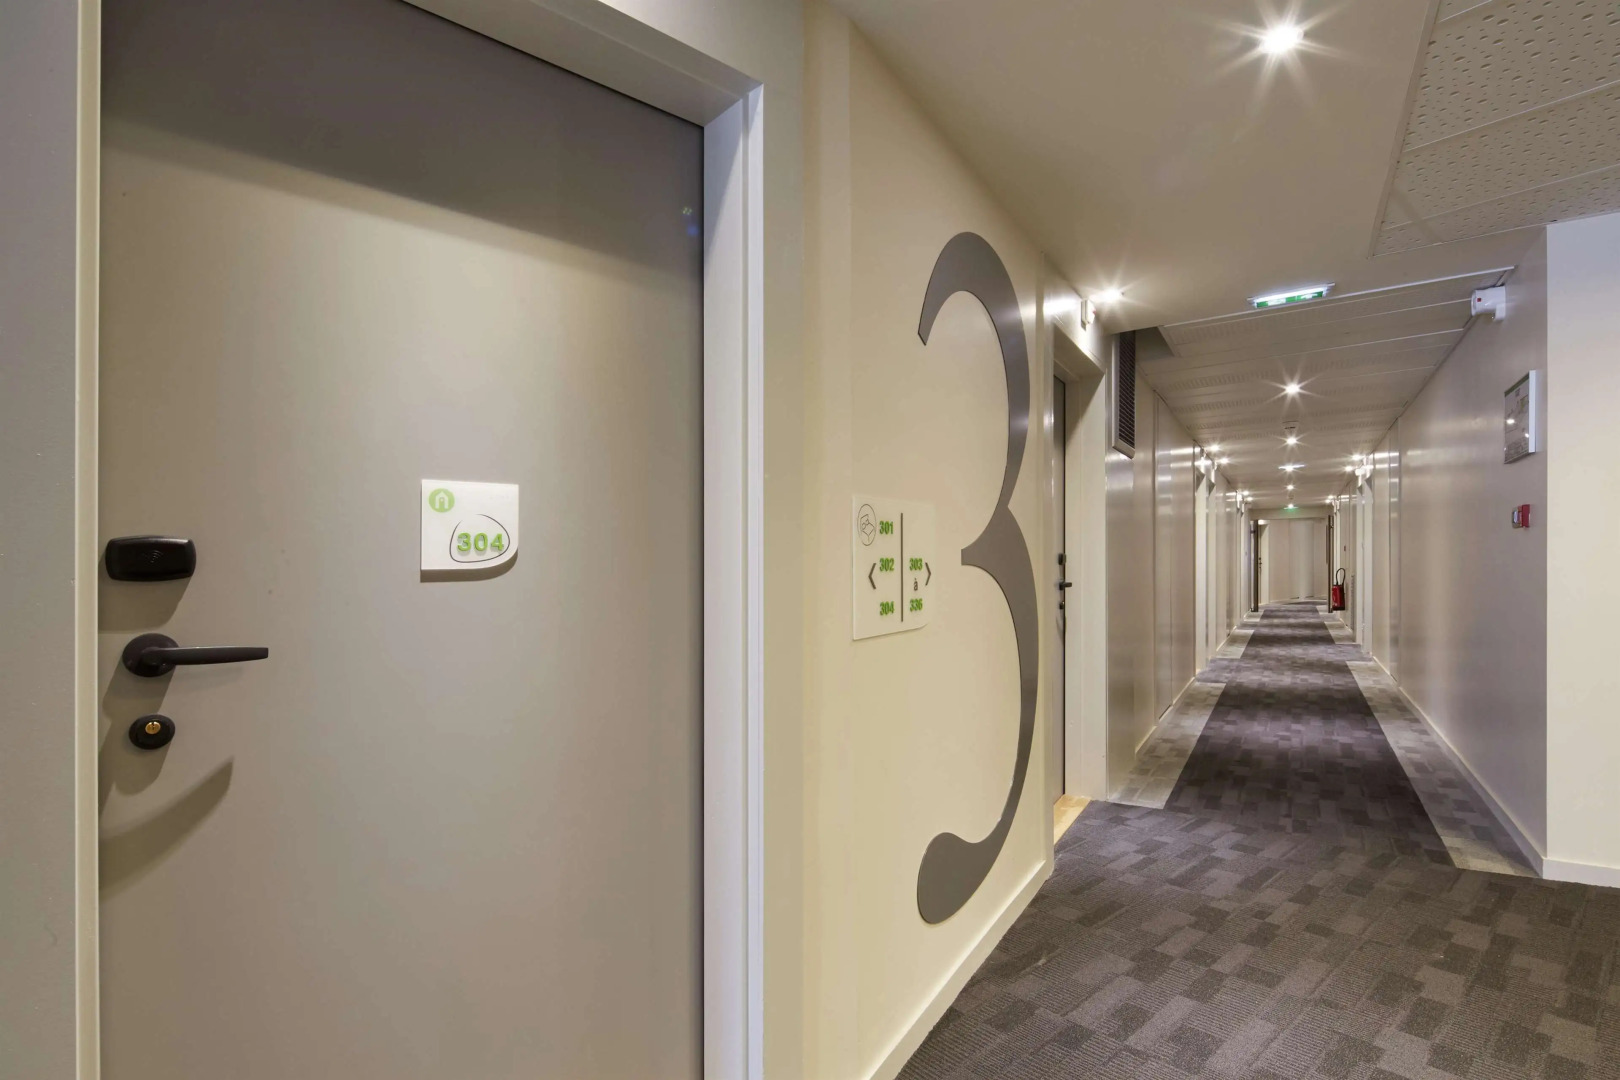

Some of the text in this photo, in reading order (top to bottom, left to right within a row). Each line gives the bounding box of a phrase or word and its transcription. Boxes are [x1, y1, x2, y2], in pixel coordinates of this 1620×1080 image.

[879, 521, 894, 534] 301
[457, 532, 504, 551] 304
[879, 558, 895, 571] 302
[909, 558, 923, 571] 303
[913, 577, 918, 591] à
[917, 232, 1038, 924] 3
[879, 601, 894, 616] 304
[909, 598, 923, 612] 336
